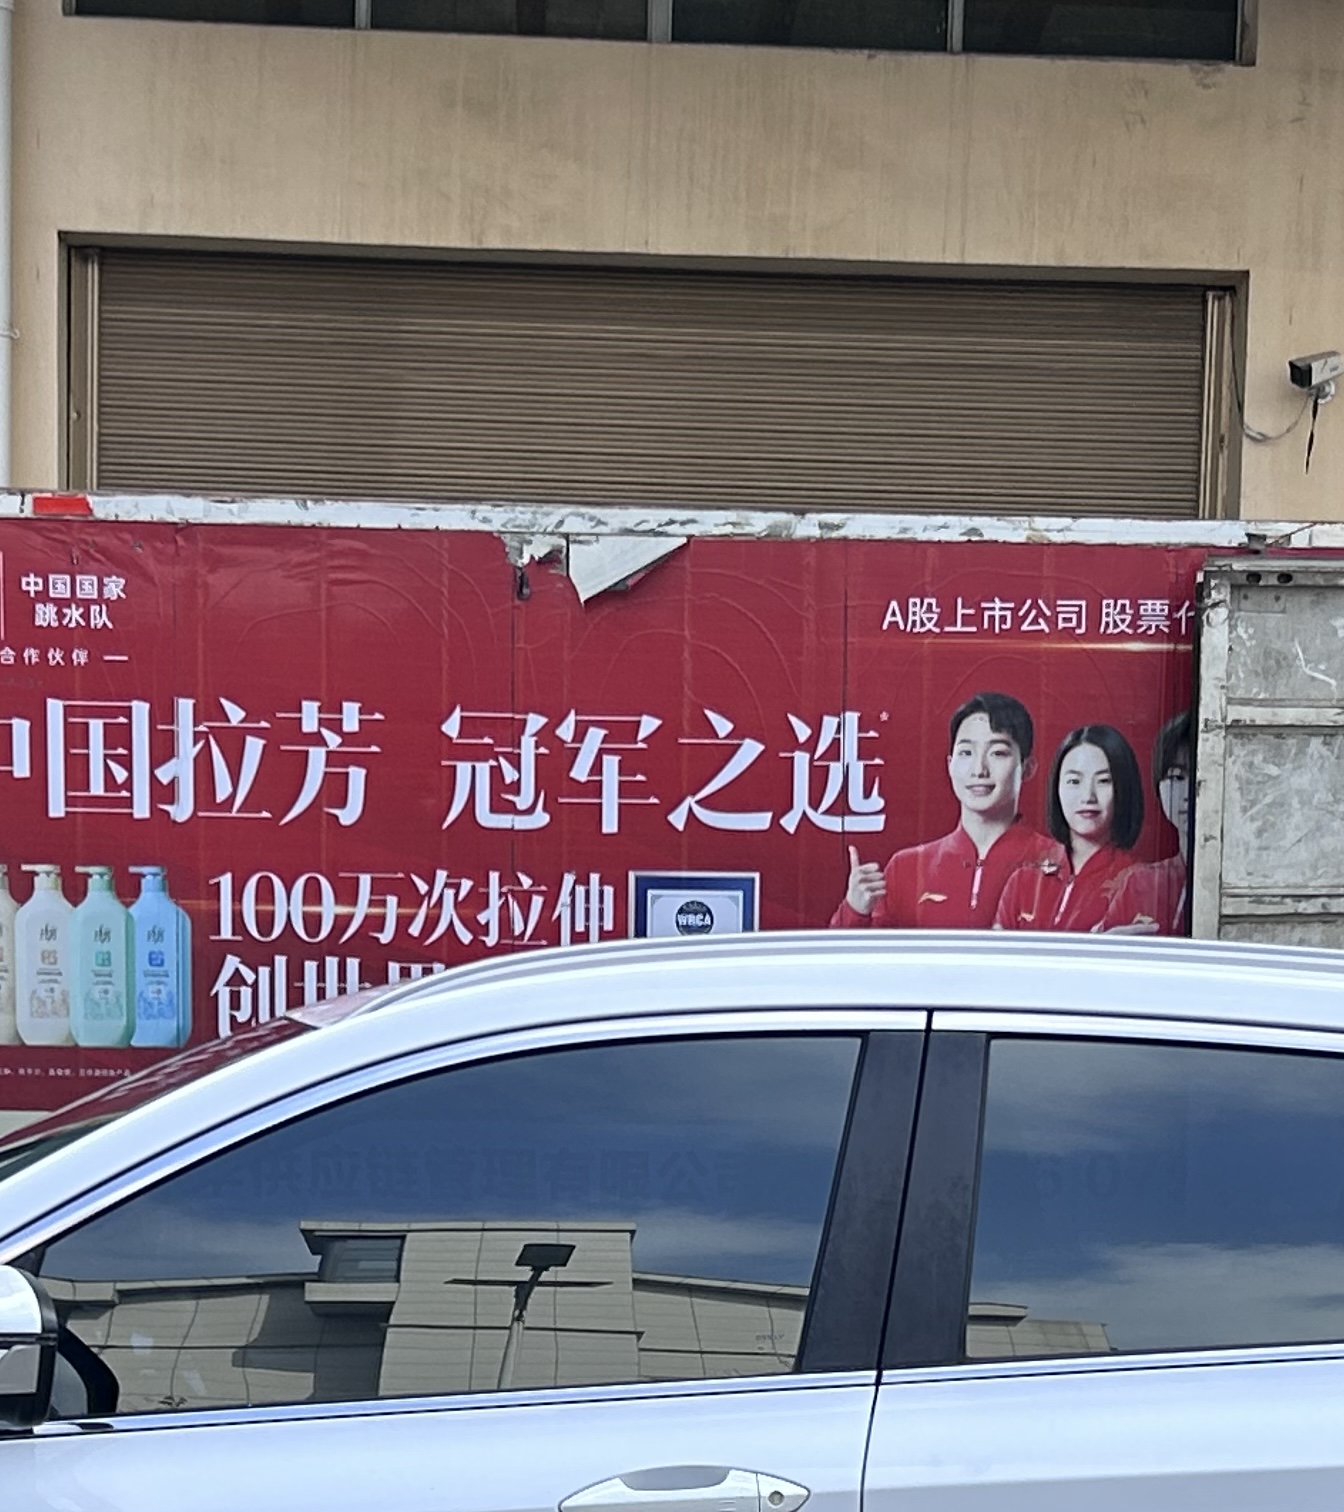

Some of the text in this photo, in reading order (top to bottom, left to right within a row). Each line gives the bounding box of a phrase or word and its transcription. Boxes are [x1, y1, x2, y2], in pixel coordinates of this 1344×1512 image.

[20, 572, 127, 601] 中国国家
[34, 603, 114, 630] 跳水队
[882, 597, 1088, 635] A股上市公司
[441, 704, 887, 836] 冠军之选
[209, 868, 616, 948] 100万次拉伸
